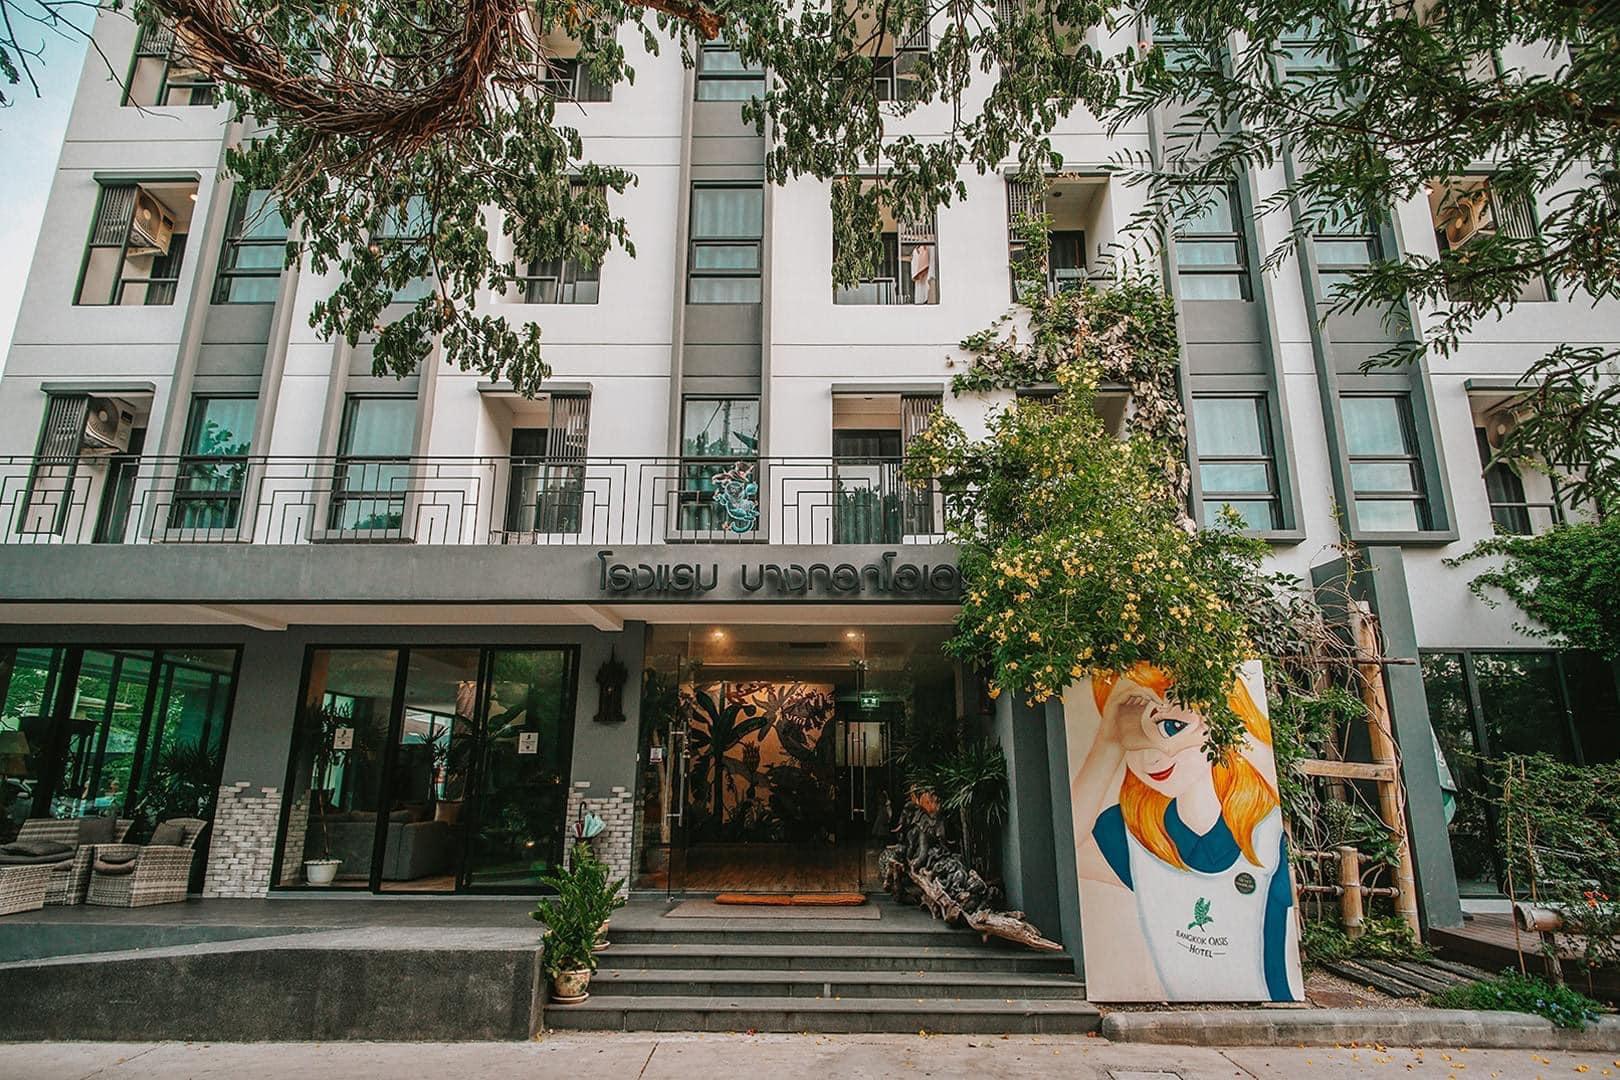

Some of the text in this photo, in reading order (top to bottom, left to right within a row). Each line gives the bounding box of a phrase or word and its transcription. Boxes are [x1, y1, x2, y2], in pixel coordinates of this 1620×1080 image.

[597, 550, 719, 592] โรงแรม
[1175, 929, 1229, 946] BANGKOK OASIS
[1189, 943, 1213, 958] HOTEL
